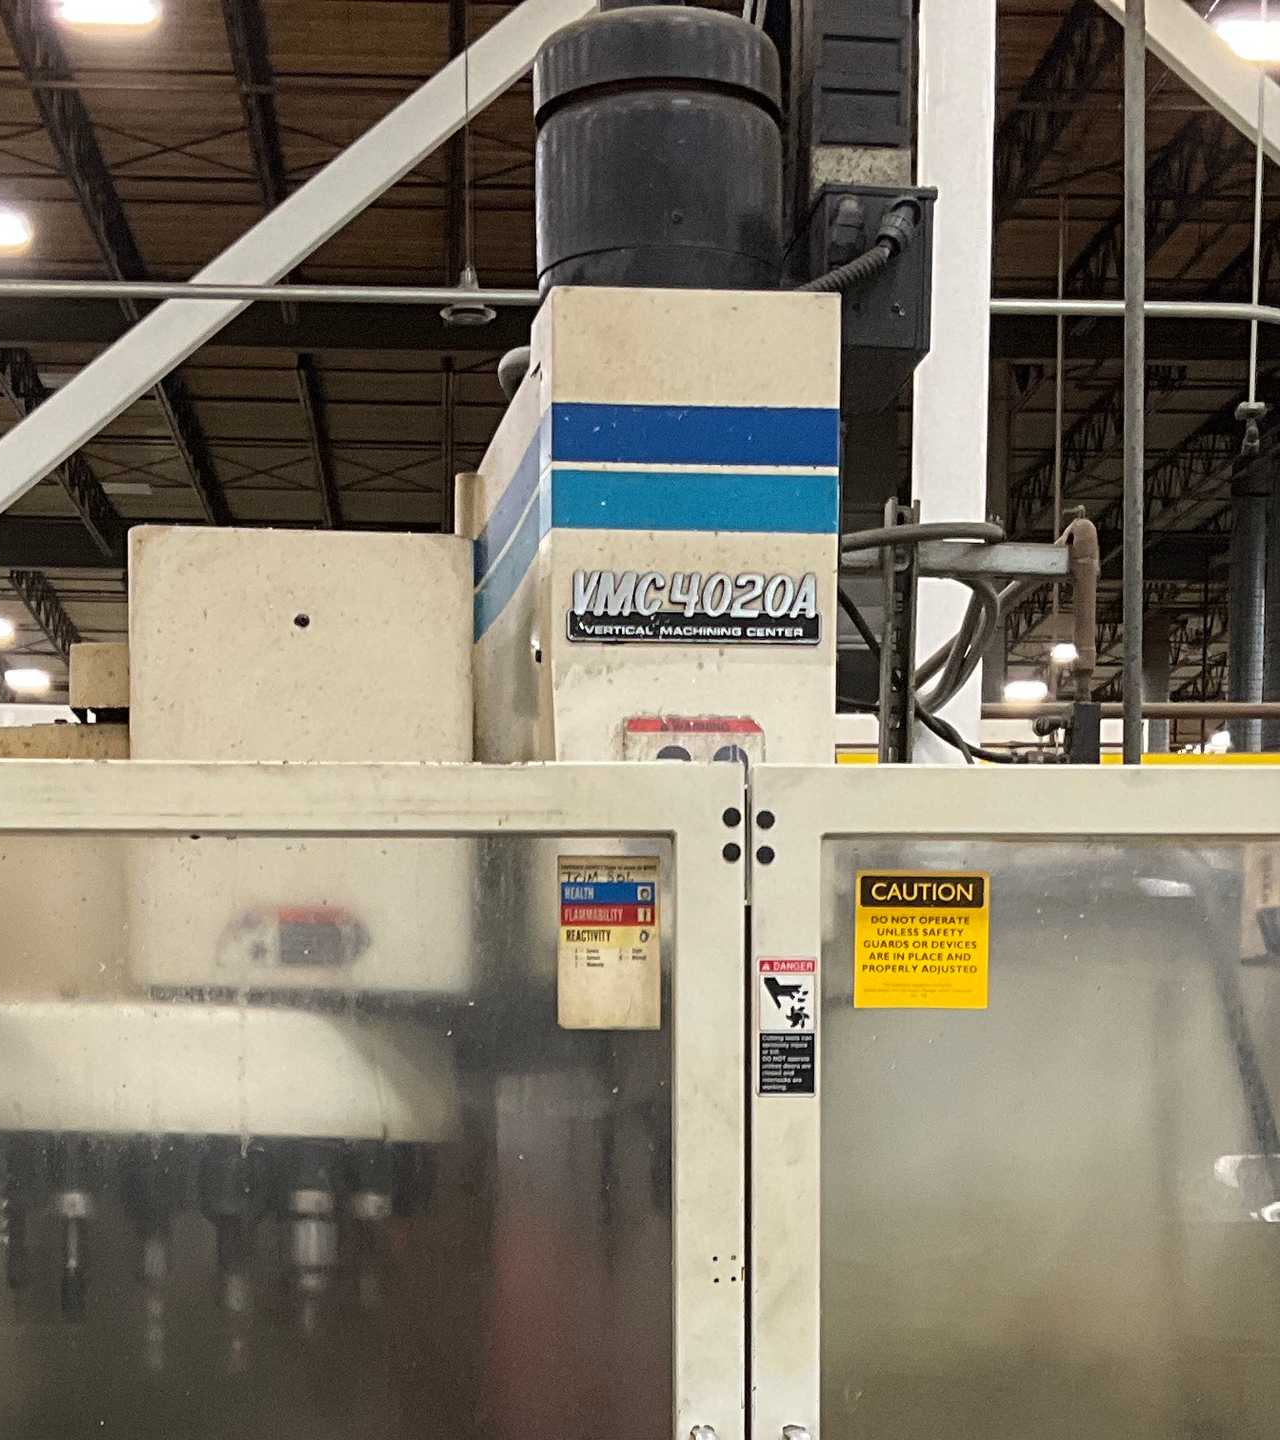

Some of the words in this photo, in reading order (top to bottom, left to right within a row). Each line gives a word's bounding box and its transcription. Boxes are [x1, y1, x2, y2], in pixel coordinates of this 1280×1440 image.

[573, 570, 666, 616] VMC
[670, 572, 817, 619] 4020A
[584, 625, 654, 636] VERTICAL
[660, 626, 741, 637] MACHINING
[746, 627, 804, 638] CENTER
[564, 887, 595, 900] HEALTH
[870, 882, 974, 902] CAUTION
[564, 908, 624, 922] FLAMMABILITY
[870, 915, 889, 925] DO
[891, 915, 916, 925] NOT
[918, 915, 971, 925] OPERATE
[565, 929, 611, 943] REACTIVITY
[876, 927, 920, 937] UNLESS
[921, 927, 965, 937] SAFETY
[863, 939, 910, 949] GUARDS
[911, 940, 929, 949] OR
[930, 940, 978, 950] DEVICES
[868, 952, 890, 961] ARE
[893, 952, 906, 961] IN
[908, 952, 943, 961] PLACE
[946, 952, 972, 962] AND
[773, 961, 813, 971] DANGER
[861, 964, 919, 974] PROPERLY
[921, 965, 978, 975] ADJUSTED
